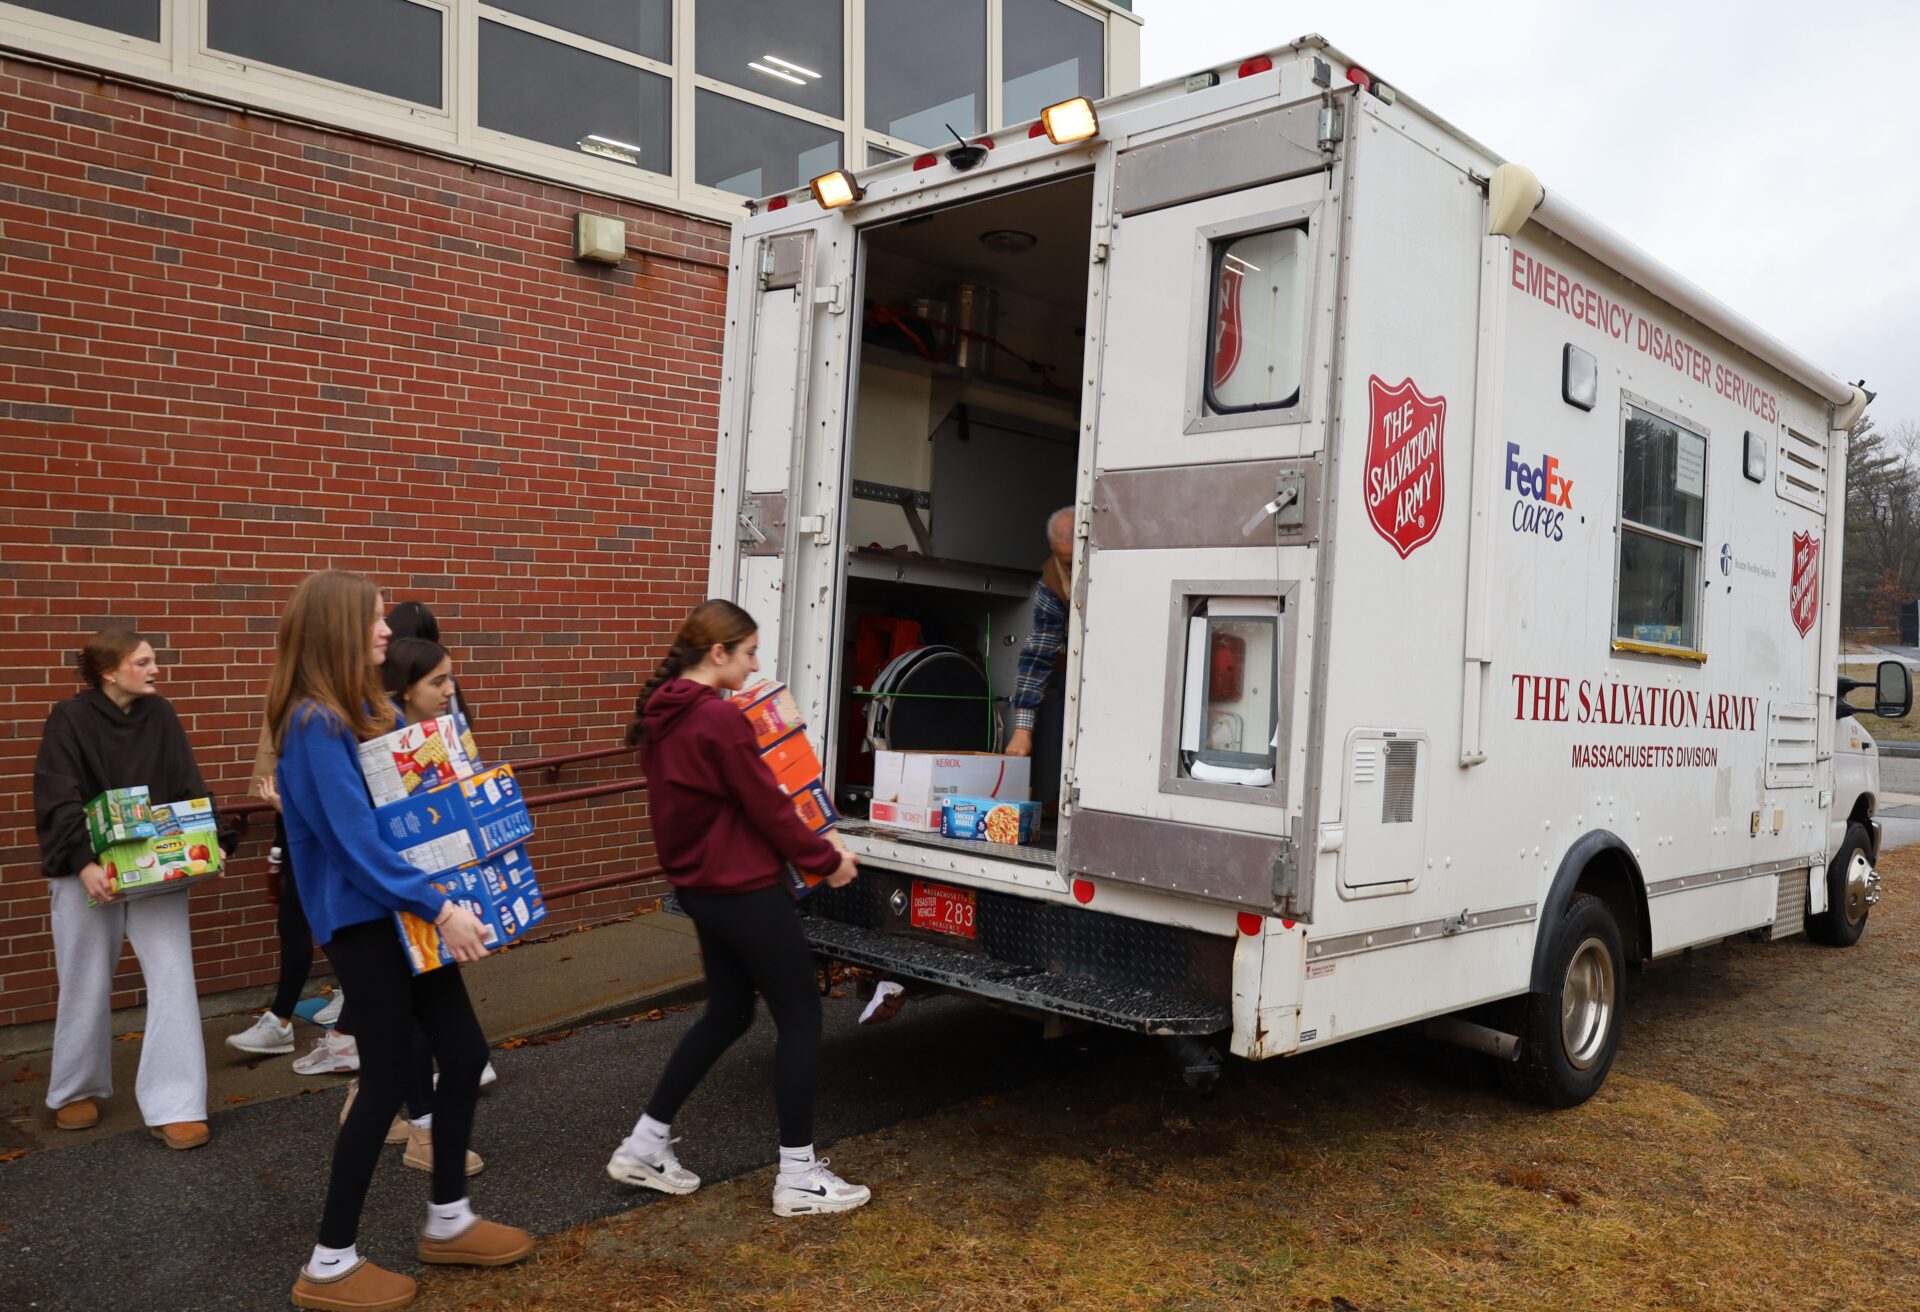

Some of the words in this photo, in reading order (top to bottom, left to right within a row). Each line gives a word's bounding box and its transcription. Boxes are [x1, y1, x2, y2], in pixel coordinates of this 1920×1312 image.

[1511, 248, 1633, 344] EMERGENCY
[1637, 317, 1712, 388] DISASTER
[1715, 363, 1776, 425] SERVICES
[1383, 399, 1414, 449] THE
[1370, 414, 1438, 507] SALVATION
[1505, 441, 1574, 510] FedEx
[1394, 462, 1434, 534] ARMY
[1512, 499, 1564, 542] cares
[1797, 543, 1809, 574] THE
[1512, 673, 1570, 722] THE
[1577, 679, 1700, 728] SALVATION
[1703, 693, 1759, 731] ARMY
[1571, 744, 1674, 768] MASSACHUSETTS
[1676, 747, 1718, 768] DIVISION
[915, 897, 936, 907] DISASTER
[918, 907, 936, 917] VEHICLE
[945, 900, 973, 926] 283
